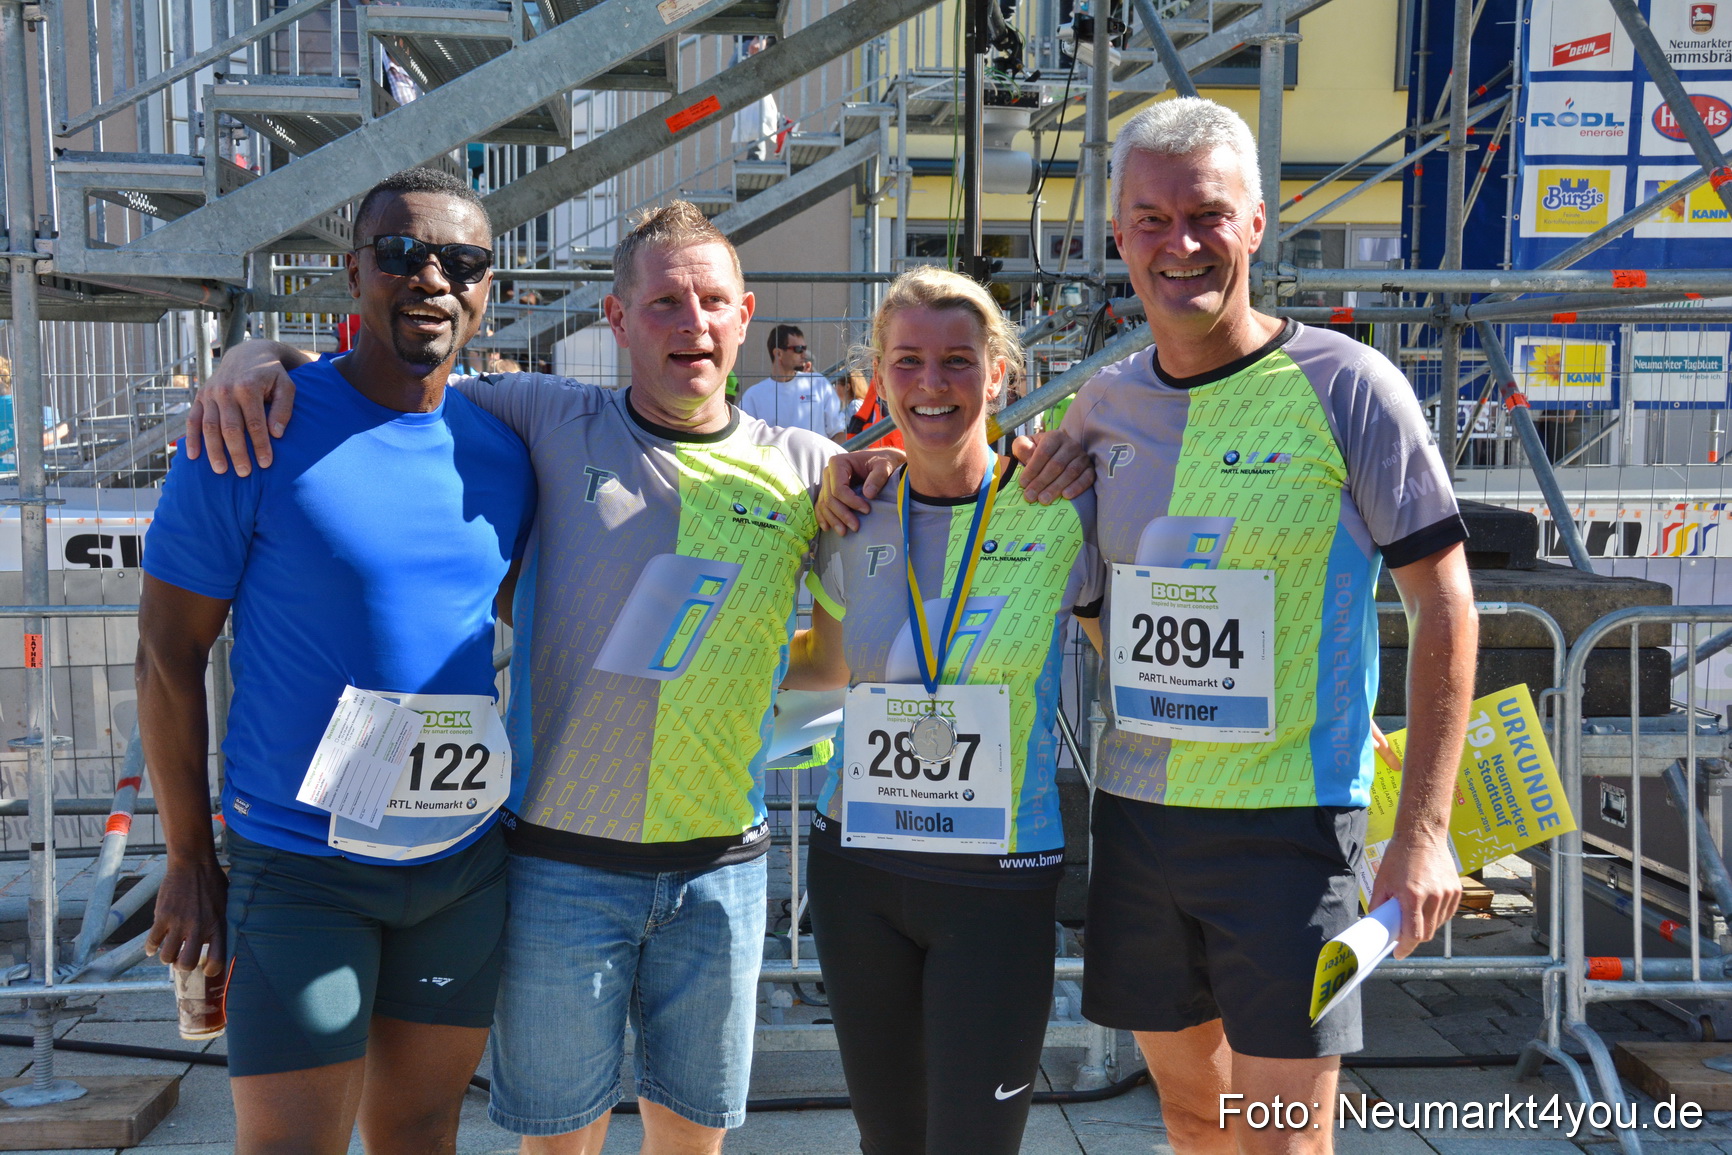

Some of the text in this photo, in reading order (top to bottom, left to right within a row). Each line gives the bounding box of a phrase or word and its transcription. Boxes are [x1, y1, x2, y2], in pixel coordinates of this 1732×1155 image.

[1569, 42, 1596, 57] DEHN
[1669, 38, 1732, 48] Neumarkter
[1542, 186, 1604, 211] Burgis
[1692, 209, 1728, 219] KANN
[1567, 373, 1601, 383] KANN
[1151, 582, 1218, 603] BOCK
[1131, 613, 1244, 669] 2894
[1118, 651, 1124, 660] A
[1139, 671, 1218, 688] PARTL Neumarkt
[887, 698, 956, 717] BOCK
[1150, 695, 1218, 721] Werner
[418, 710, 472, 728] OCK
[853, 766, 859, 776] A
[1497, 697, 1561, 832] URKUNDE
[1466, 710, 1529, 838] 19. Neumarkter
[878, 786, 958, 800] PARTL Neumarkt
[1478, 759, 1512, 828] Stadtlauf
[387, 799, 463, 810] RTL Neumarkt
[1466, 777, 1484, 818] September
[1481, 815, 1492, 833] 2018
[895, 810, 954, 833] Nicola
